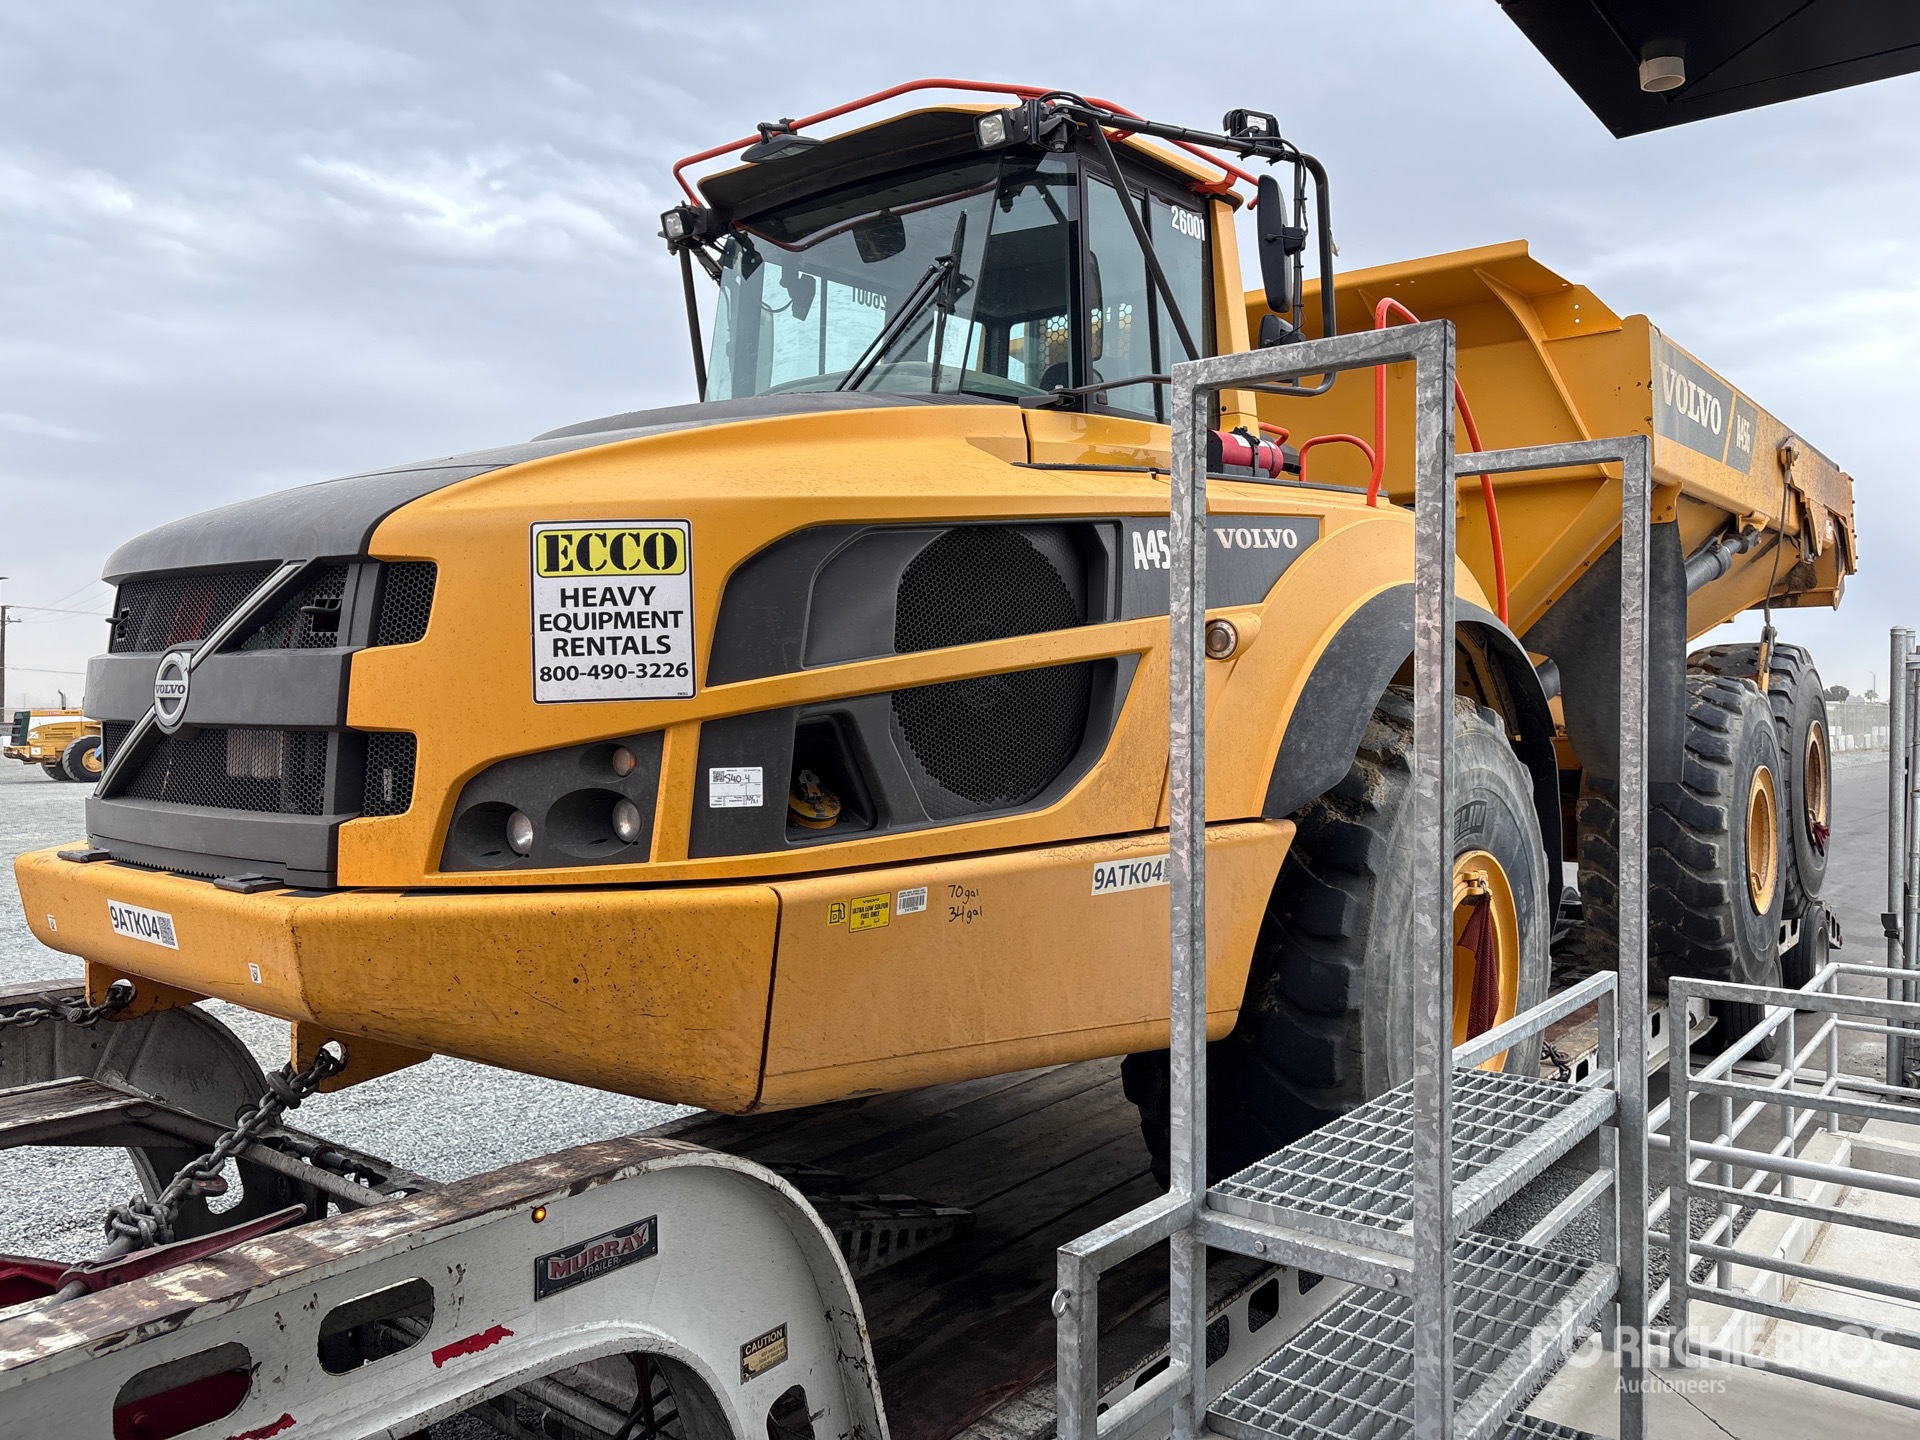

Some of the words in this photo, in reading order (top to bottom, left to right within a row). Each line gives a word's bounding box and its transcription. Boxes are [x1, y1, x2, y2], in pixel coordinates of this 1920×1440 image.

[1171, 205, 1206, 241] 26001
[1659, 361, 1722, 435] VOLVO
[543, 532, 678, 572] ECCO
[1132, 529, 1173, 570] A45
[1213, 528, 1298, 549] VOLVO
[560, 586, 656, 608] HEAVY
[539, 610, 684, 633] EQUIPMENT
[552, 635, 672, 657] RENTALS
[539, 662, 689, 682] 800-490-3226
[155, 684, 186, 694] VOLVO
[1094, 860, 1162, 890] 9ATK04
[109, 905, 160, 939] 9ATK04
[582, 1257, 619, 1277] TRAILER
[745, 1328, 783, 1355] CAUTION
